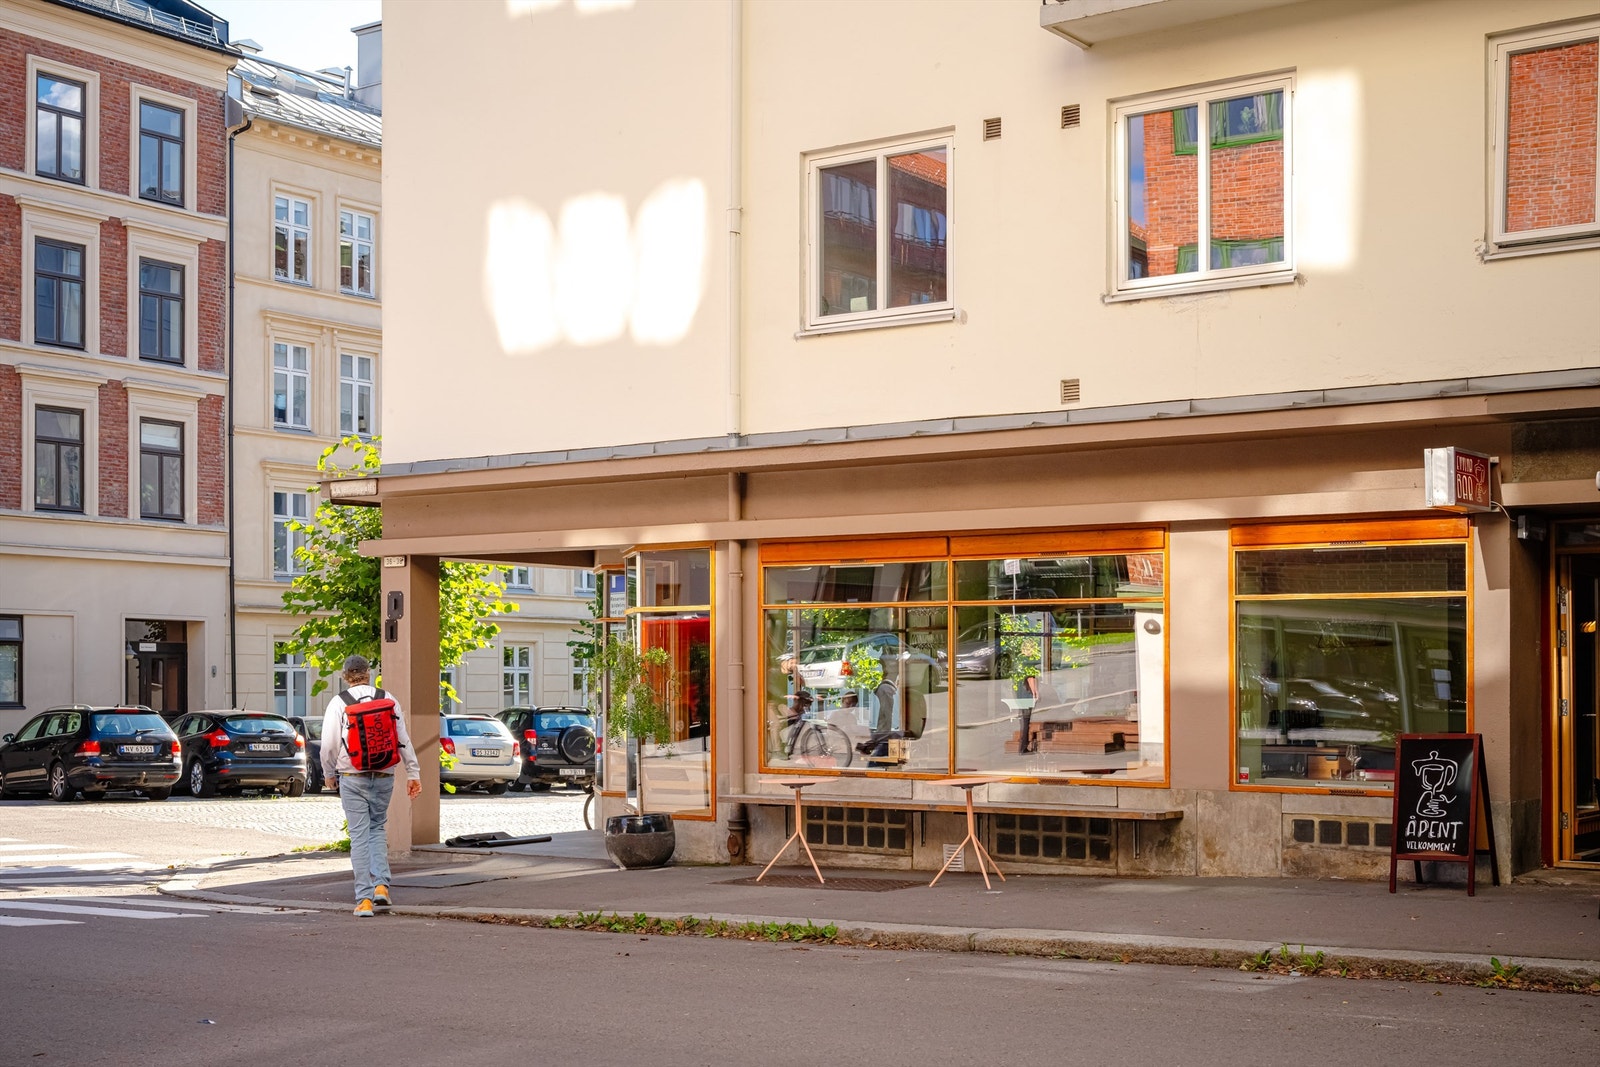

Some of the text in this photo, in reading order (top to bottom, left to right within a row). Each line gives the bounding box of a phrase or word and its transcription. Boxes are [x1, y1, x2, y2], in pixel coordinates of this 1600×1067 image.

[1456, 474, 1474, 501] BAR
[367, 726, 378, 753] FACE
[374, 713, 384, 751] NORTH
[383, 728, 394, 749] THE
[1405, 815, 1463, 840] ÅPENT
